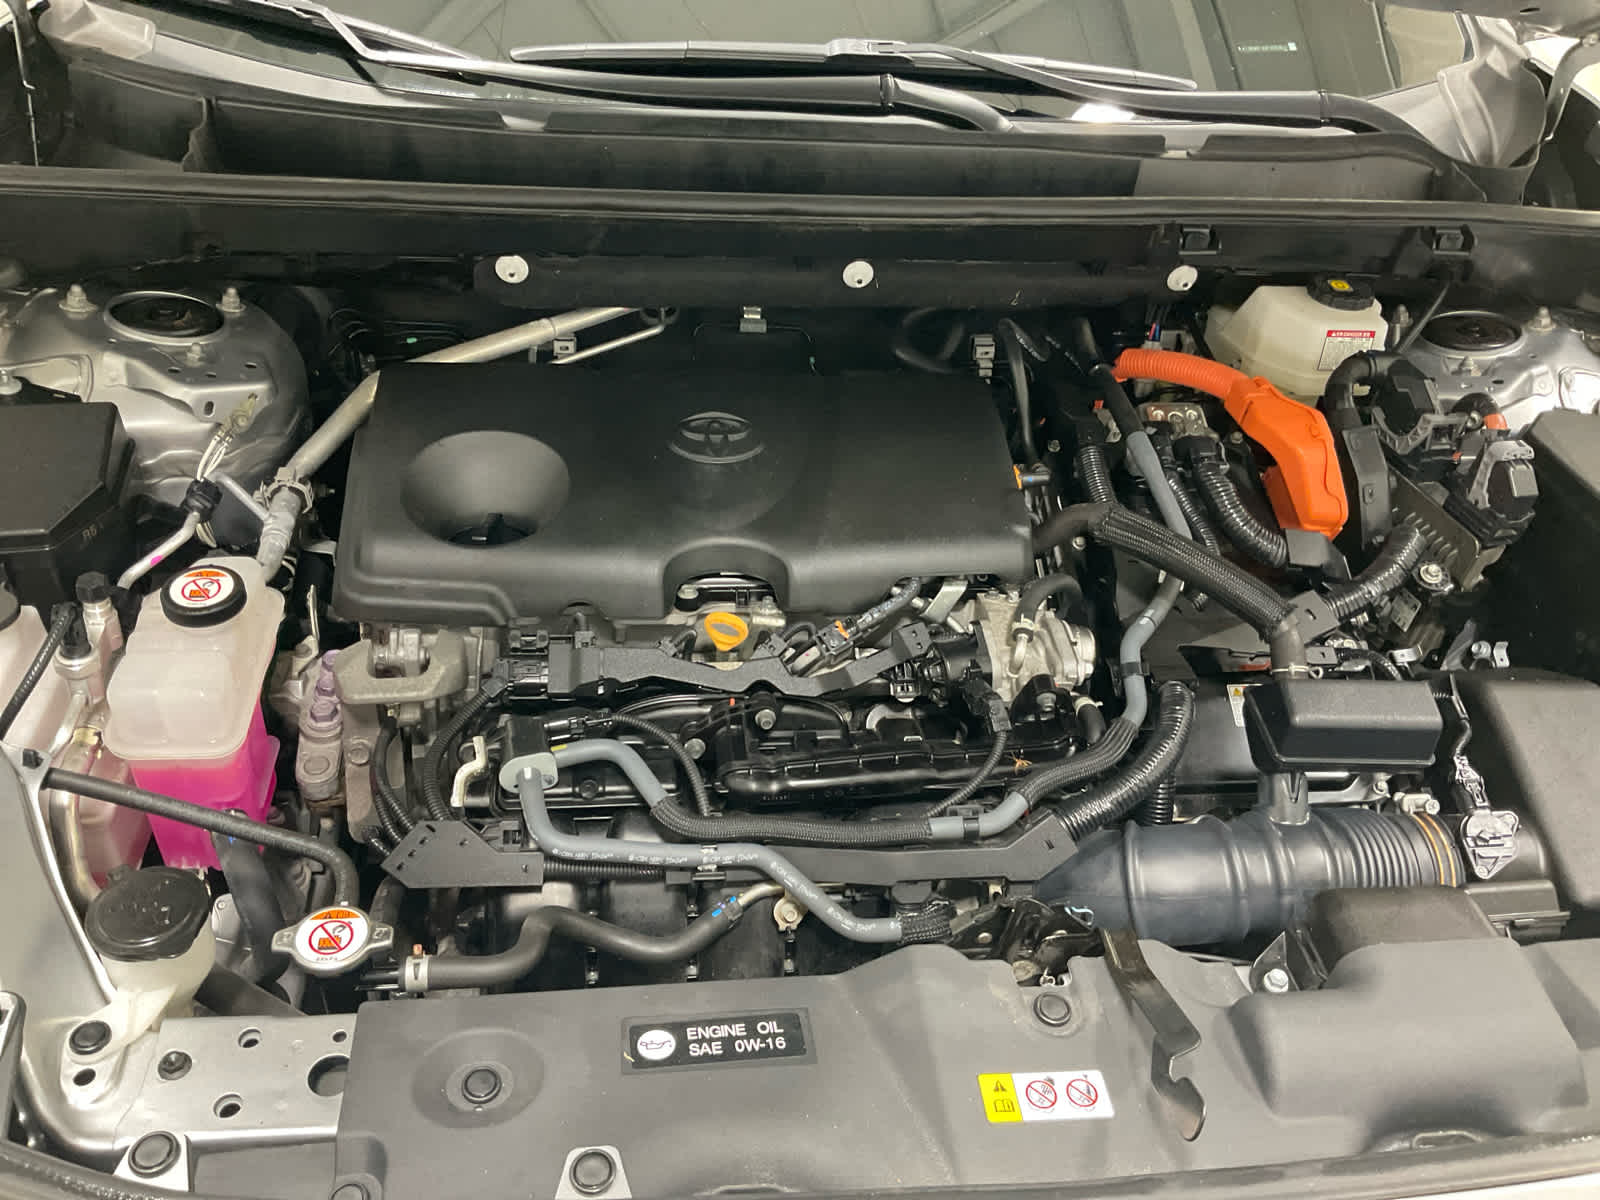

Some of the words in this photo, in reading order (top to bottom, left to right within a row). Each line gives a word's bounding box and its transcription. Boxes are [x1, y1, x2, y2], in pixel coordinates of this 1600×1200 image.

[686, 1023, 747, 1040] ENGINE
[756, 1020, 785, 1035] OIL
[688, 1041, 724, 1056] SAE
[734, 1036, 787, 1053] 0W-16
